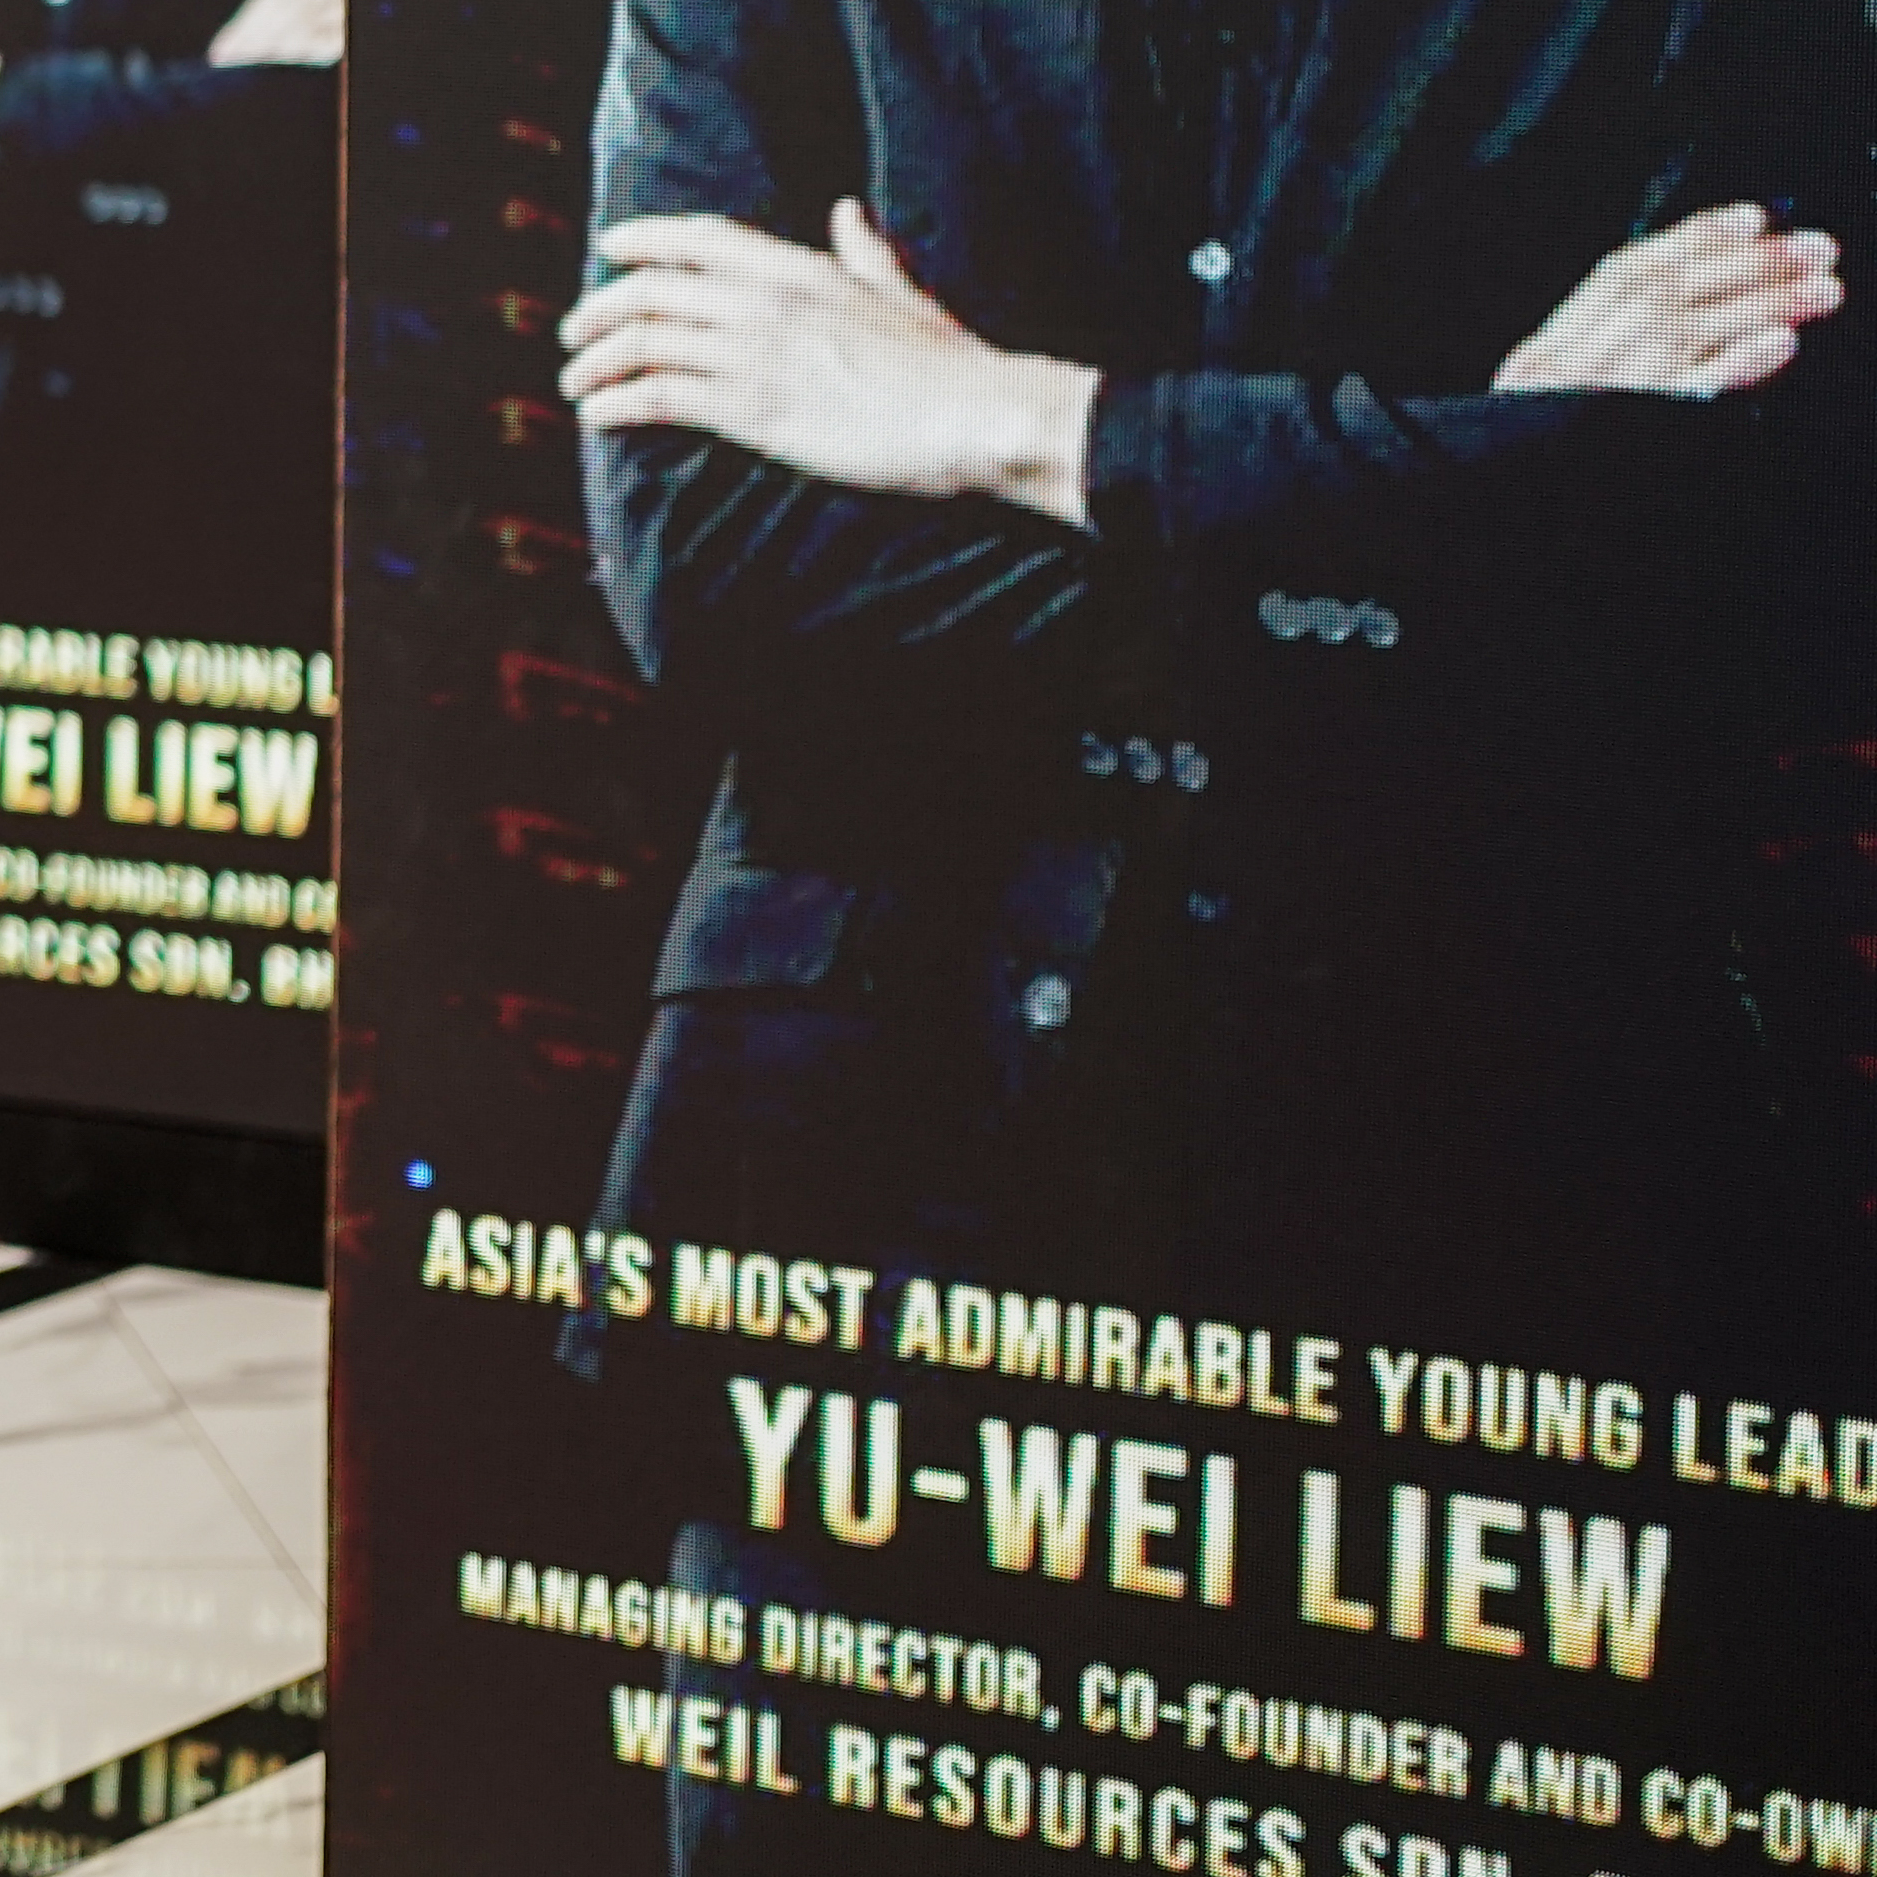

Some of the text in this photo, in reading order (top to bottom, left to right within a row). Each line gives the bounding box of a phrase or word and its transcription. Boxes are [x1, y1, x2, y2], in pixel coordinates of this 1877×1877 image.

[144, 638, 303, 714] YOUNG
[104, 714, 319, 838] LIEW
[128, 927, 251, 1004] SDN.
[261, 943, 335, 1012] BH
[422, 1208, 1877, 1511] ASIA'S MOST ADMIRABLE YOUNG LEAD
[728, 1377, 1669, 1679] YU-WEI LIEW
[460, 1553, 1877, 1875] MANAGING DIRECTOR, CO-FOUNDER AND CO-OW
[611, 1685, 798, 1795] WEIL
[829, 1724, 1306, 1877] RESOURCES
